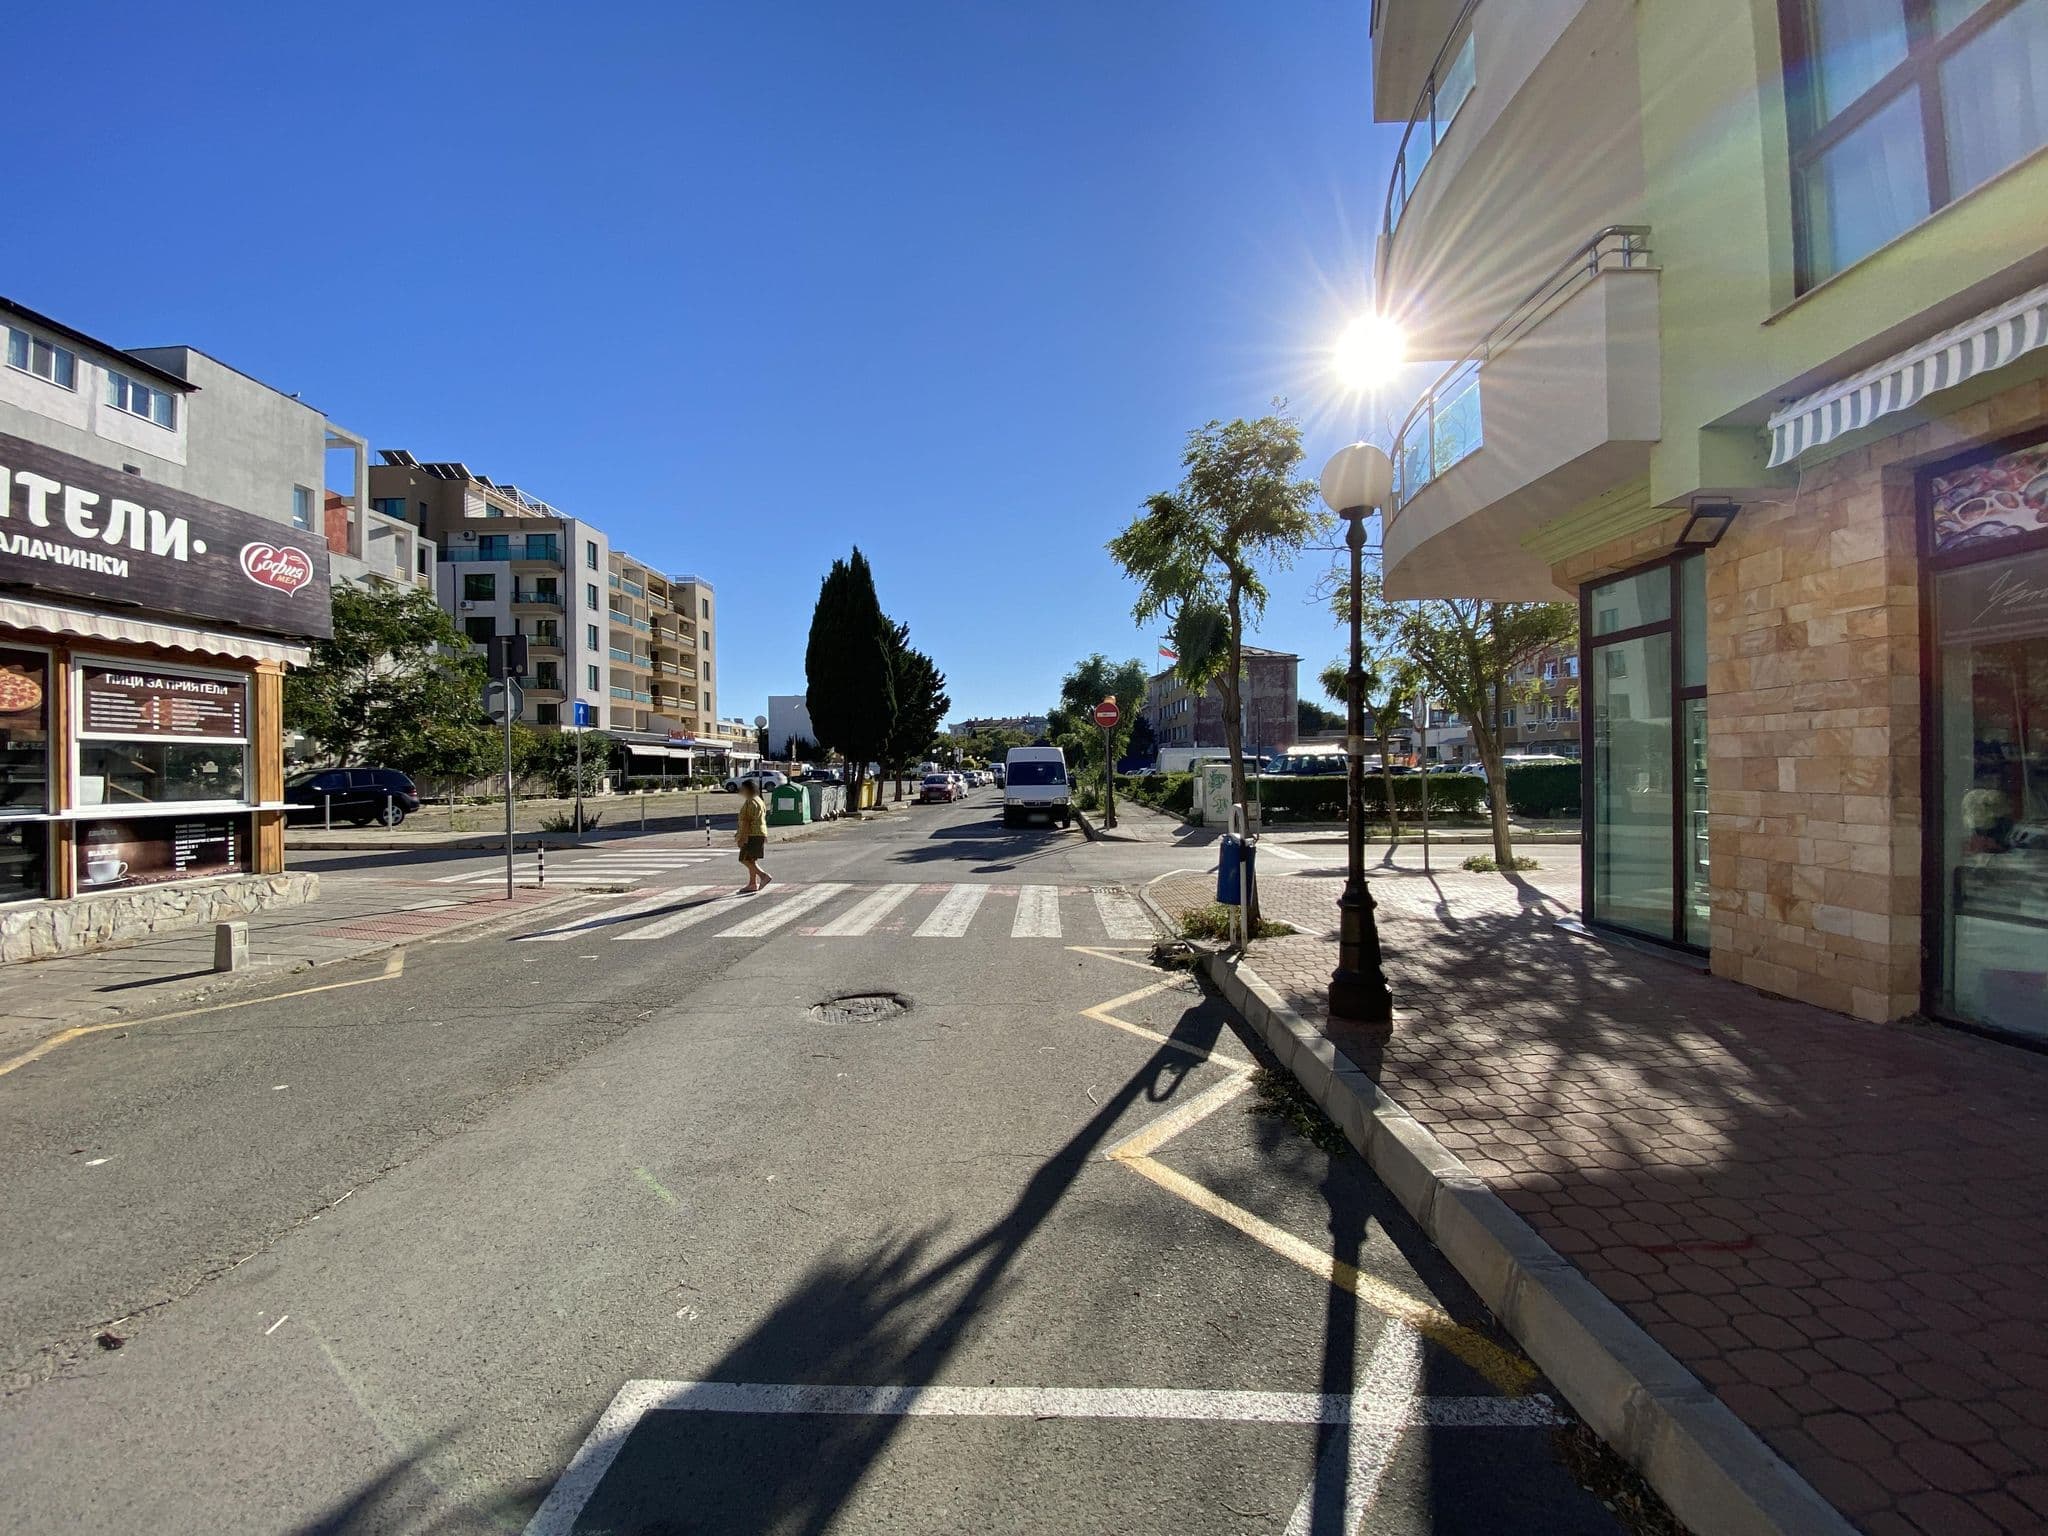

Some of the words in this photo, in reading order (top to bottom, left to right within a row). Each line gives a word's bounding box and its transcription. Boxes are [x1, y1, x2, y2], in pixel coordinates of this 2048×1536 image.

[247, 546, 305, 582] София
[105, 673, 144, 688] ПИЦИ
[146, 679, 164, 689] ЗА
[166, 679, 229, 695] ПРИЯТЕЛИ
